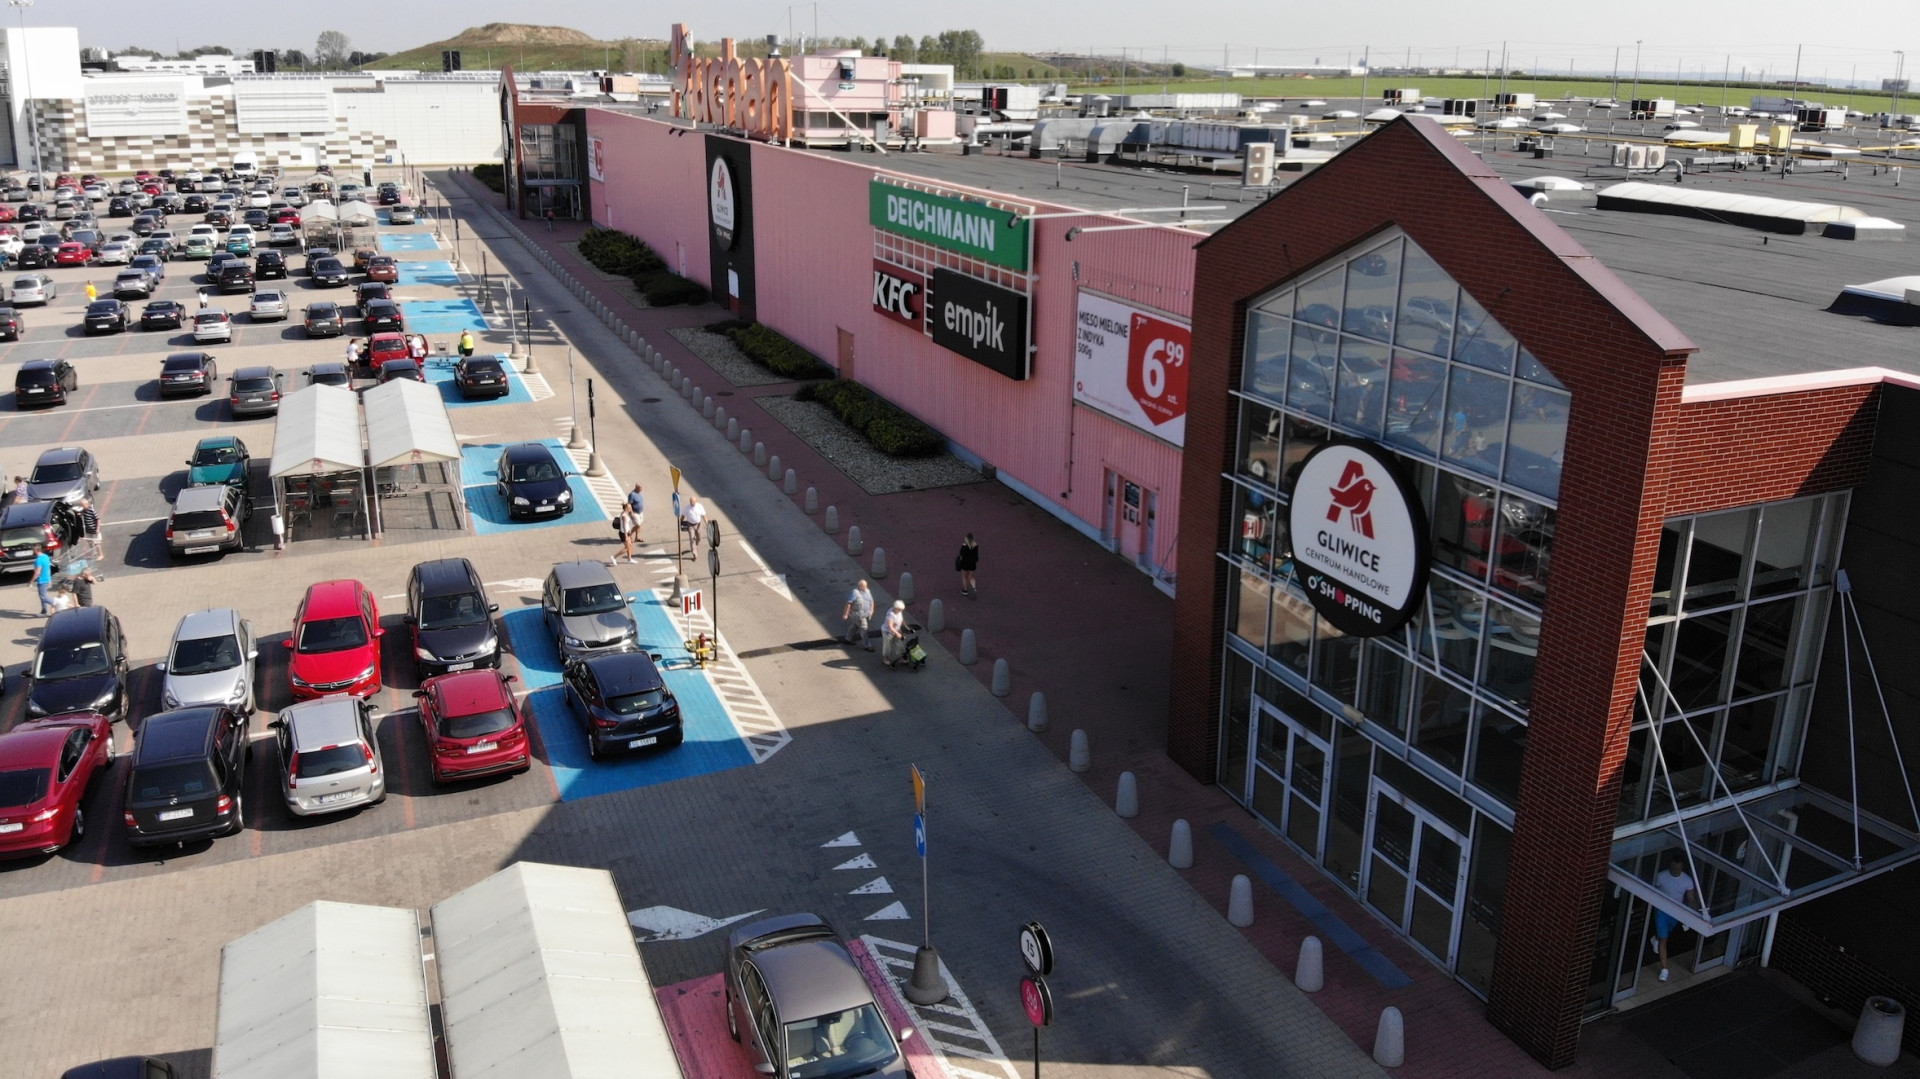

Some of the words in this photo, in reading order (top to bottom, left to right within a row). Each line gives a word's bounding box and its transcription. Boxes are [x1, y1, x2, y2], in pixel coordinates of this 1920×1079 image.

[887, 194, 995, 251] DEICHMANN
[872, 271, 915, 320] KFC
[944, 300, 1005, 352] empik
[1082, 330, 1105, 347] INDYKA
[1099, 317, 1129, 338] MIELONE
[1078, 342, 1093, 360] 500g
[1305, 547, 1342, 571] CENTRUM
[1342, 566, 1391, 596] HANDLOWE
[1317, 530, 1381, 573] GLIWICE
[689, 595, 696, 612] H
